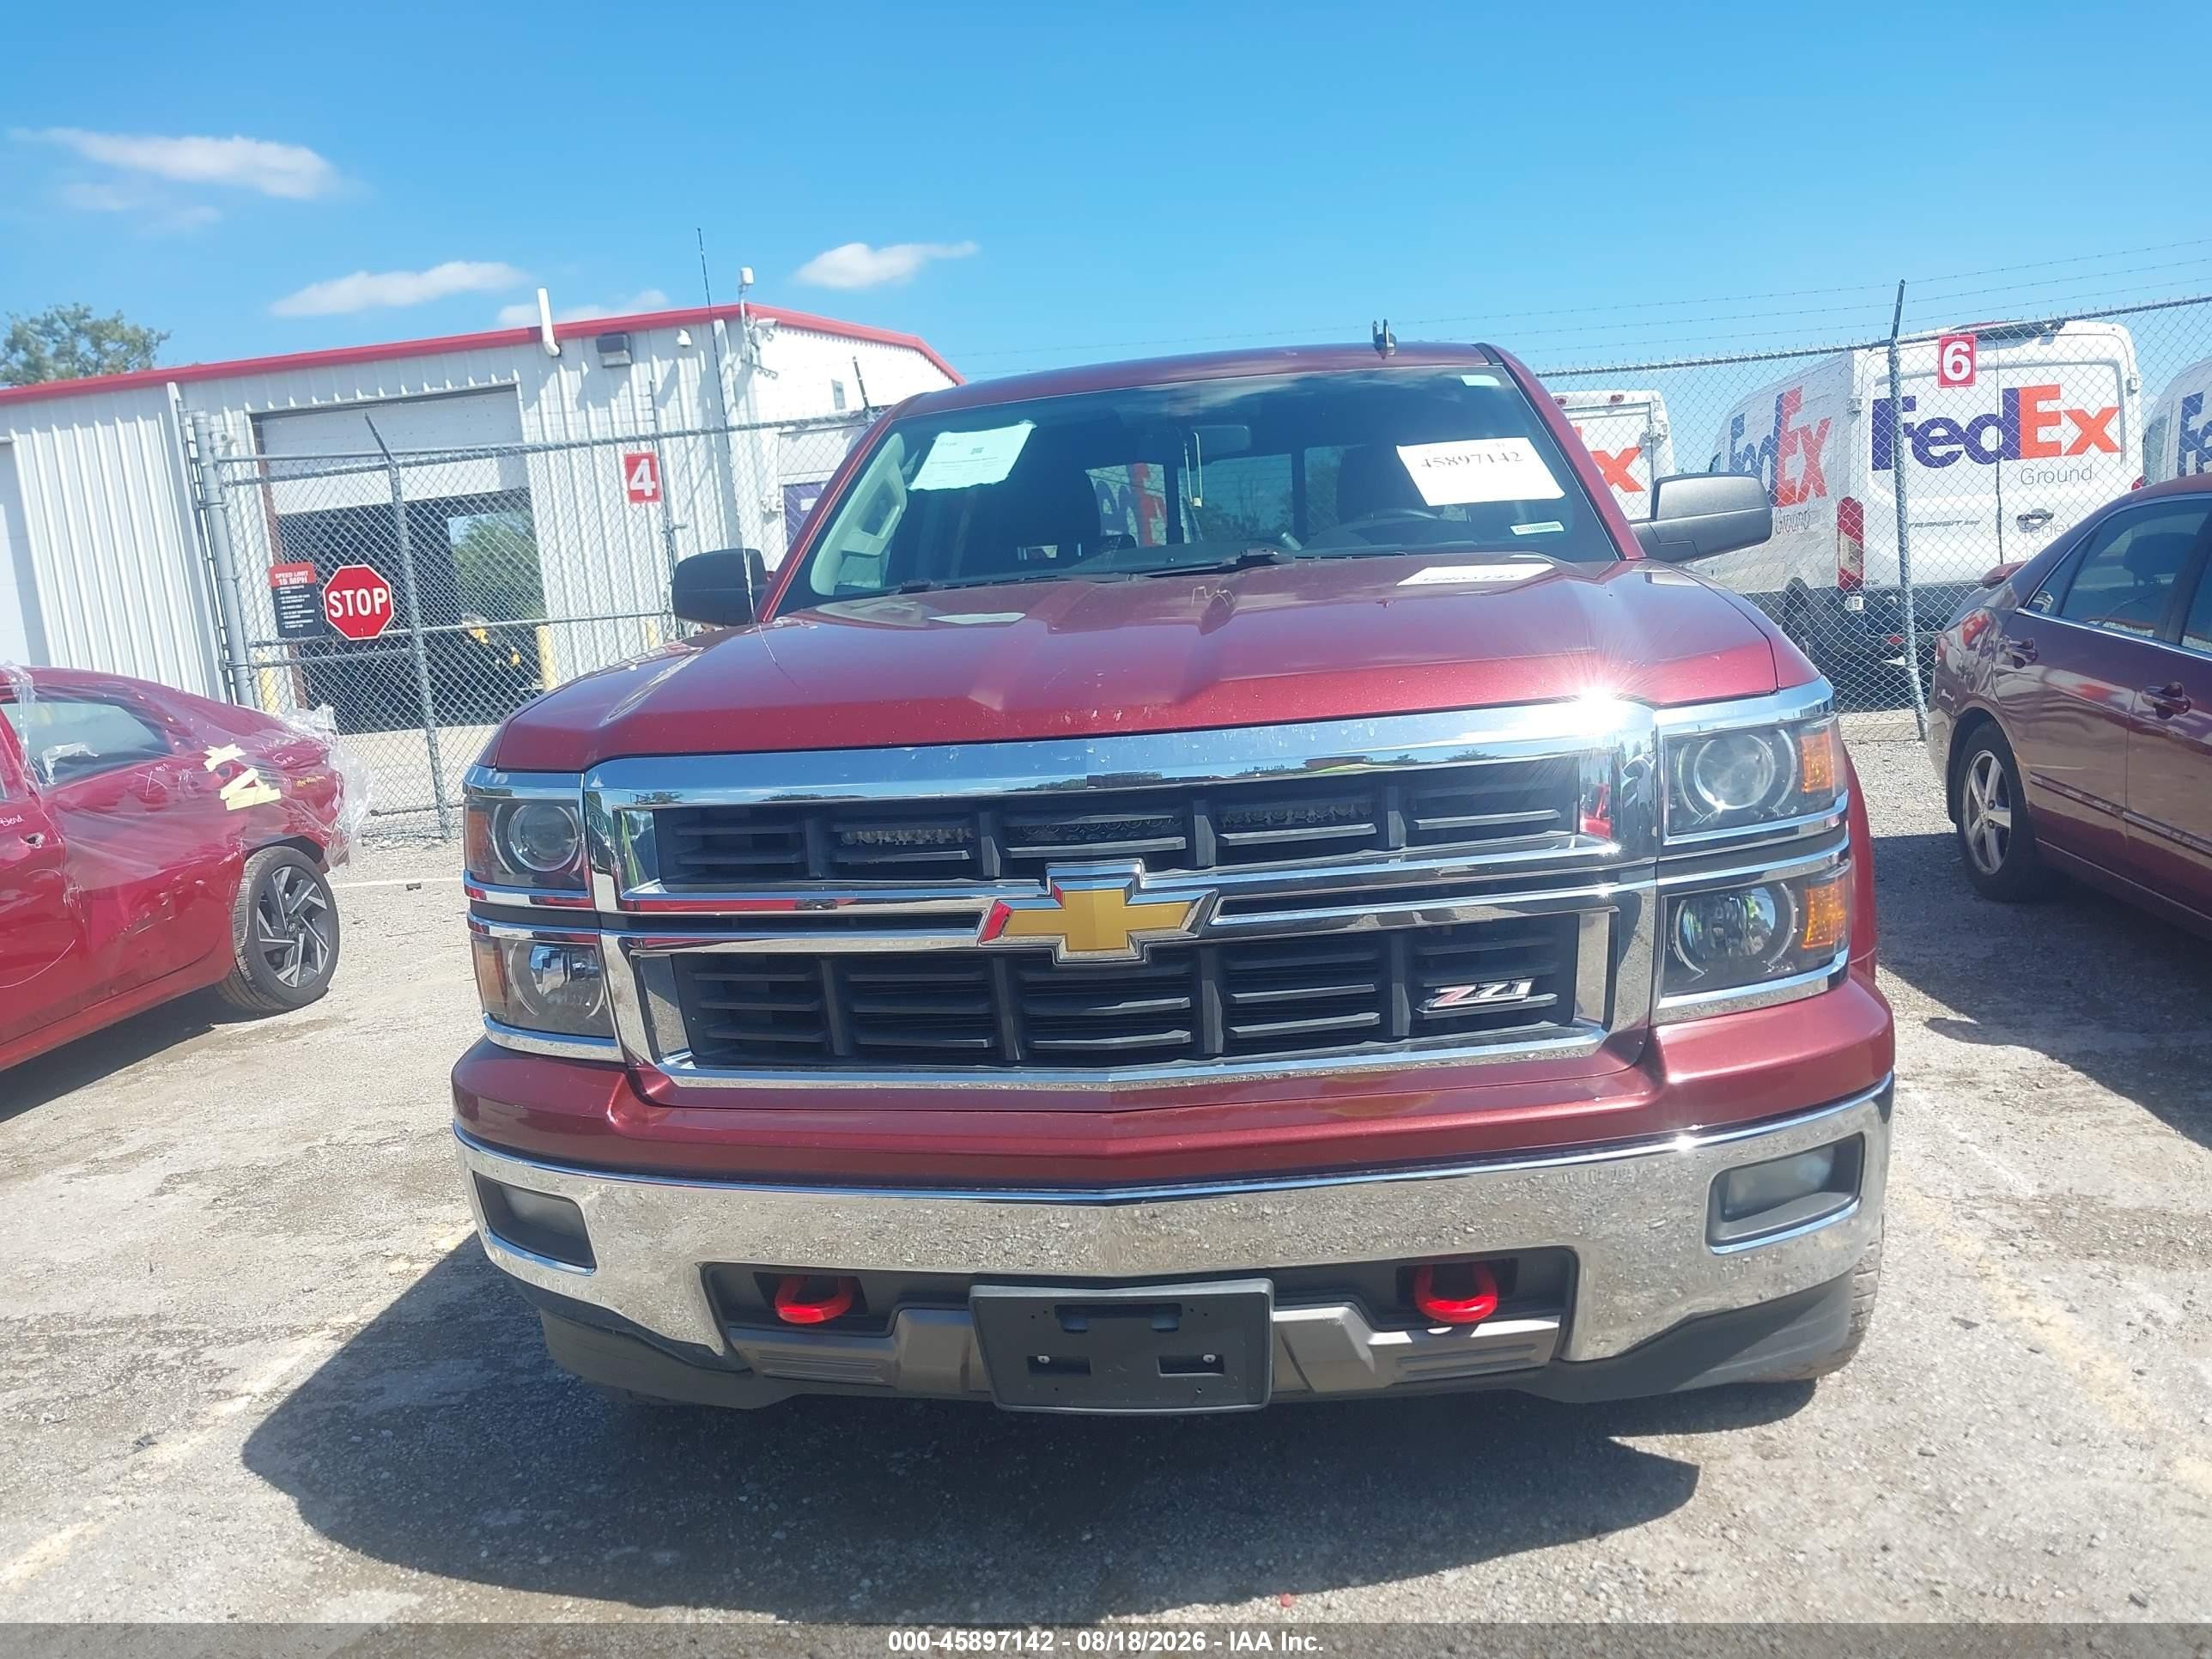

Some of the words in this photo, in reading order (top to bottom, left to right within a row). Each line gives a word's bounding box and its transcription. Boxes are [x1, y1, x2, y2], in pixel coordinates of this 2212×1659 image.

[1942, 341, 1972, 381] 6
[1872, 384, 2122, 471] FedEx
[629, 459, 656, 497] 4
[2020, 465, 2093, 485] Ground
[329, 587, 387, 618] STOP
